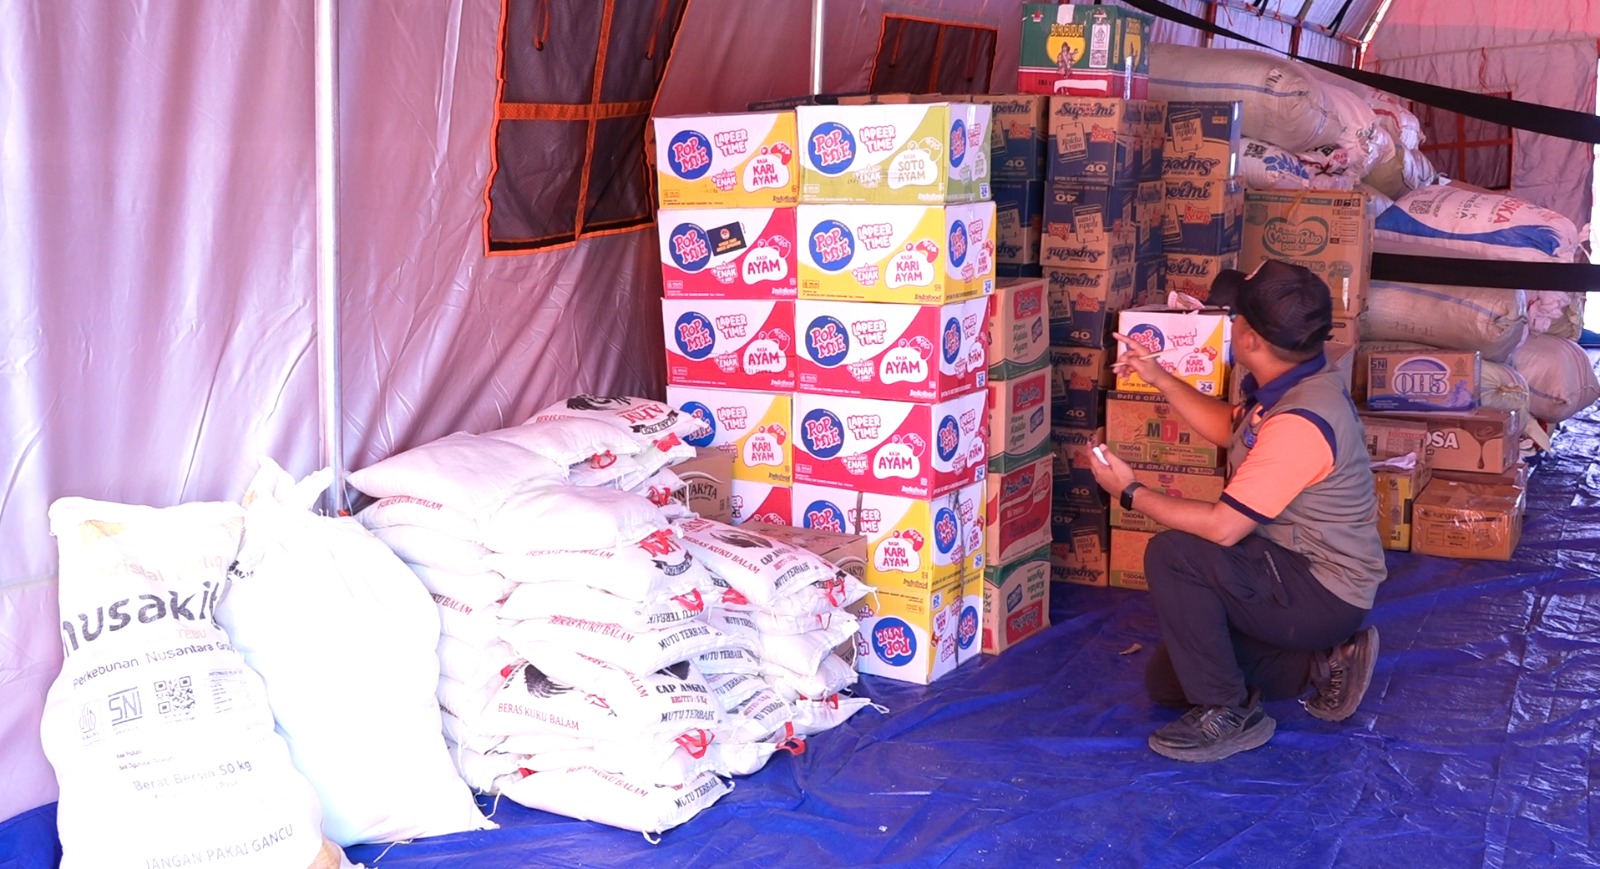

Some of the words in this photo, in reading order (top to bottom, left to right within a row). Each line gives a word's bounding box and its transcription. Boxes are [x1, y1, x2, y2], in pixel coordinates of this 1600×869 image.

[992, 100, 1031, 115] upermi
[714, 128, 748, 146] LAPEER
[859, 125, 896, 141] LAPEER
[813, 130, 842, 153] POP
[864, 138, 894, 153] TIME
[673, 137, 699, 162] POP
[720, 142, 747, 157] TIME
[821, 142, 852, 166] MIE
[681, 147, 709, 173] MIE
[898, 159, 924, 171] SOTO
[1005, 160, 1024, 168] 40
[1162, 154, 1221, 178] Super
[753, 164, 774, 174] KARI
[1085, 164, 1107, 172] 40
[753, 174, 778, 186] AYAM
[898, 171, 926, 182] AYAM
[917, 193, 944, 201] Indofood
[1055, 193, 1077, 202] 40
[1165, 181, 1212, 199] ermi
[772, 195, 797, 203] Indofood
[857, 222, 893, 239] LAPEER
[674, 229, 697, 253] POP
[815, 228, 841, 250] POP
[863, 236, 891, 251] TIME
[682, 239, 709, 264] MIE
[821, 240, 851, 263] MIE
[747, 260, 781, 275] AYAM
[896, 260, 920, 271] KARI
[1165, 258, 1209, 275] ermi
[895, 271, 923, 282] AYAM
[1050, 271, 1102, 287] Supermi
[771, 287, 797, 295] Indofood
[914, 293, 942, 301] Indofood
[716, 313, 748, 330] LAPEER
[852, 319, 887, 336] LAPEER
[679, 319, 703, 341] POP
[722, 326, 746, 340] TIME
[811, 323, 837, 347] POP
[1070, 331, 1091, 339] 40
[687, 328, 713, 352] MIE
[817, 335, 846, 359] MIE
[857, 332, 885, 347] TIME
[1170, 337, 1195, 347] TIME
[748, 352, 780, 366] AYAM
[1371, 361, 1387, 369] SNI
[885, 361, 921, 375] AYAM
[770, 379, 795, 387] Indofood
[1395, 373, 1448, 393] OH5
[909, 389, 937, 398] Indofood
[717, 406, 748, 421] LAPEER
[1065, 409, 1085, 417] 40
[722, 418, 747, 431] TIME
[806, 416, 832, 437] POP
[847, 414, 881, 430] LAPEER
[812, 428, 841, 451] MIE
[852, 426, 879, 440] TIME
[752, 442, 772, 452] KARI
[751, 452, 775, 462] AYAM
[878, 456, 913, 470] AYAM
[1146, 464, 1180, 473] GRATIS
[768, 472, 791, 481] Indofood
[901, 485, 928, 495] Indofood
[1072, 487, 1089, 496] 40
[416, 498, 443, 510] BALAM
[809, 508, 833, 530] POP
[1053, 515, 1073, 523] 40
[709, 543, 732, 559] KUKU
[731, 552, 760, 574] BALAM
[760, 553, 774, 566] CAP
[884, 548, 906, 557] KARI
[882, 557, 909, 567] AYAM
[902, 578, 928, 589] Indofood
[442, 596, 473, 616] BALAM
[176, 628, 207, 639] TEBU
[576, 620, 601, 633] KUKU
[601, 626, 635, 644] BALAM
[657, 632, 680, 651] MUTU
[680, 625, 711, 641] TERBAIK
[885, 637, 912, 658] POP
[698, 651, 719, 661] MUTU
[719, 650, 743, 660] TERBAIK
[73, 657, 140, 689] Perkebunan
[145, 641, 214, 664] Nusantara
[626, 670, 649, 698] ALAM
[655, 683, 677, 694] CAP
[109, 691, 142, 722] SNI
[498, 703, 523, 715] BERAS
[524, 705, 547, 722] KUKU
[549, 713, 580, 731] BALAM
[661, 711, 684, 722] MUTU
[685, 709, 715, 721] TERBAIK
[219, 763, 236, 777] 50
[236, 760, 252, 773] kg
[615, 778, 649, 798] BALAM
[694, 777, 719, 798] TERBAIK
[146, 852, 203, 869] JANGAN
[206, 842, 250, 862] PAKAI
[251, 823, 294, 852] GANCU
